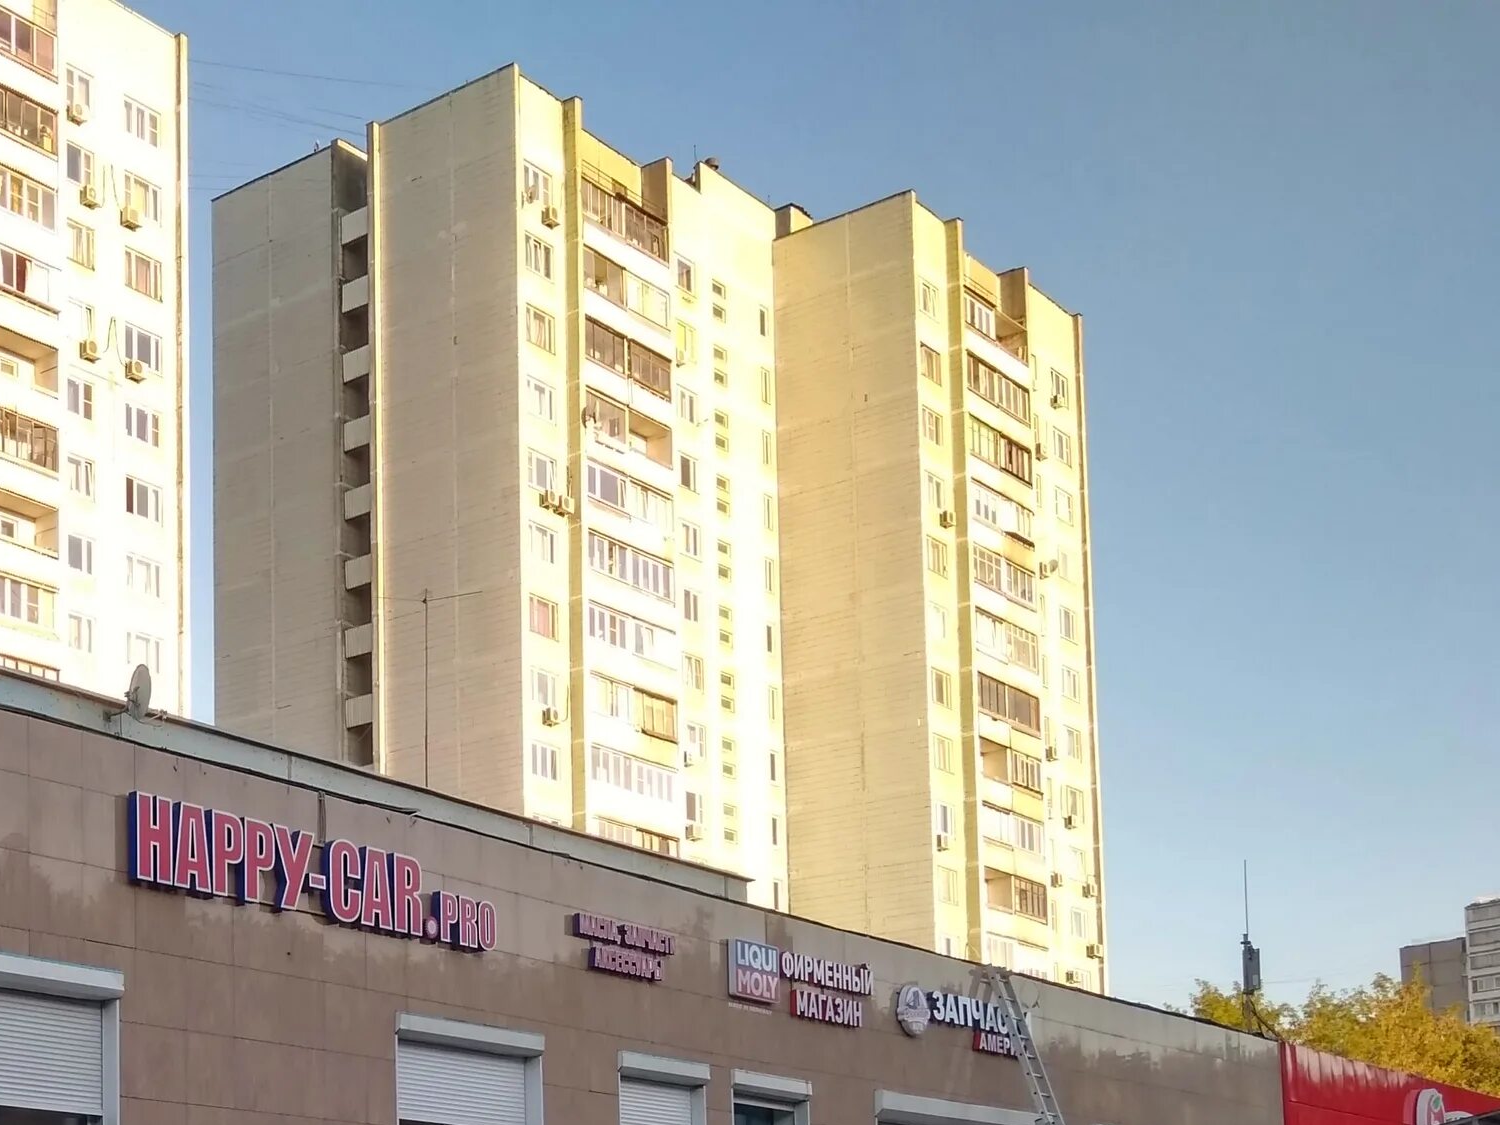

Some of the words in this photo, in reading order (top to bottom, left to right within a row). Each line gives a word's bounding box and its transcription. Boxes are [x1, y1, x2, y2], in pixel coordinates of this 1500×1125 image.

[736, 941, 778, 973] LIQUI
[781, 950, 875, 996] ФИРМЕННЫЙ
[736, 968, 779, 1000] MOLY
[795, 989, 863, 1028] МАГАЗИН
[932, 989, 1033, 1040] ЗАПЧАС
